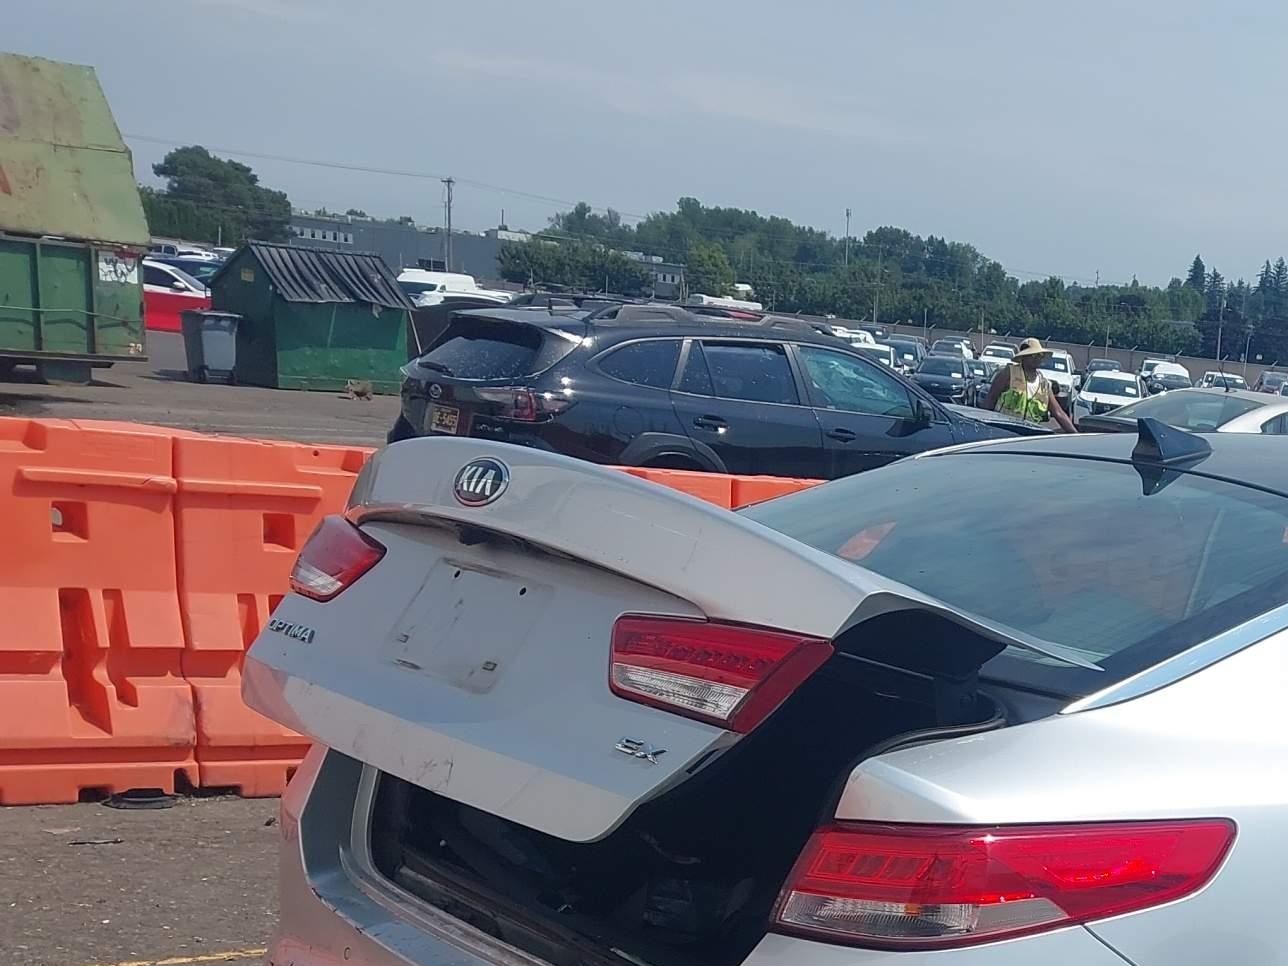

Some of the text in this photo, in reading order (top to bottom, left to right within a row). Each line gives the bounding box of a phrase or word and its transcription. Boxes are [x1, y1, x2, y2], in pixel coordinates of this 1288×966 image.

[459, 465, 496, 496] KIA
[268, 618, 314, 644] OPTIMA
[615, 738, 668, 764] EX
